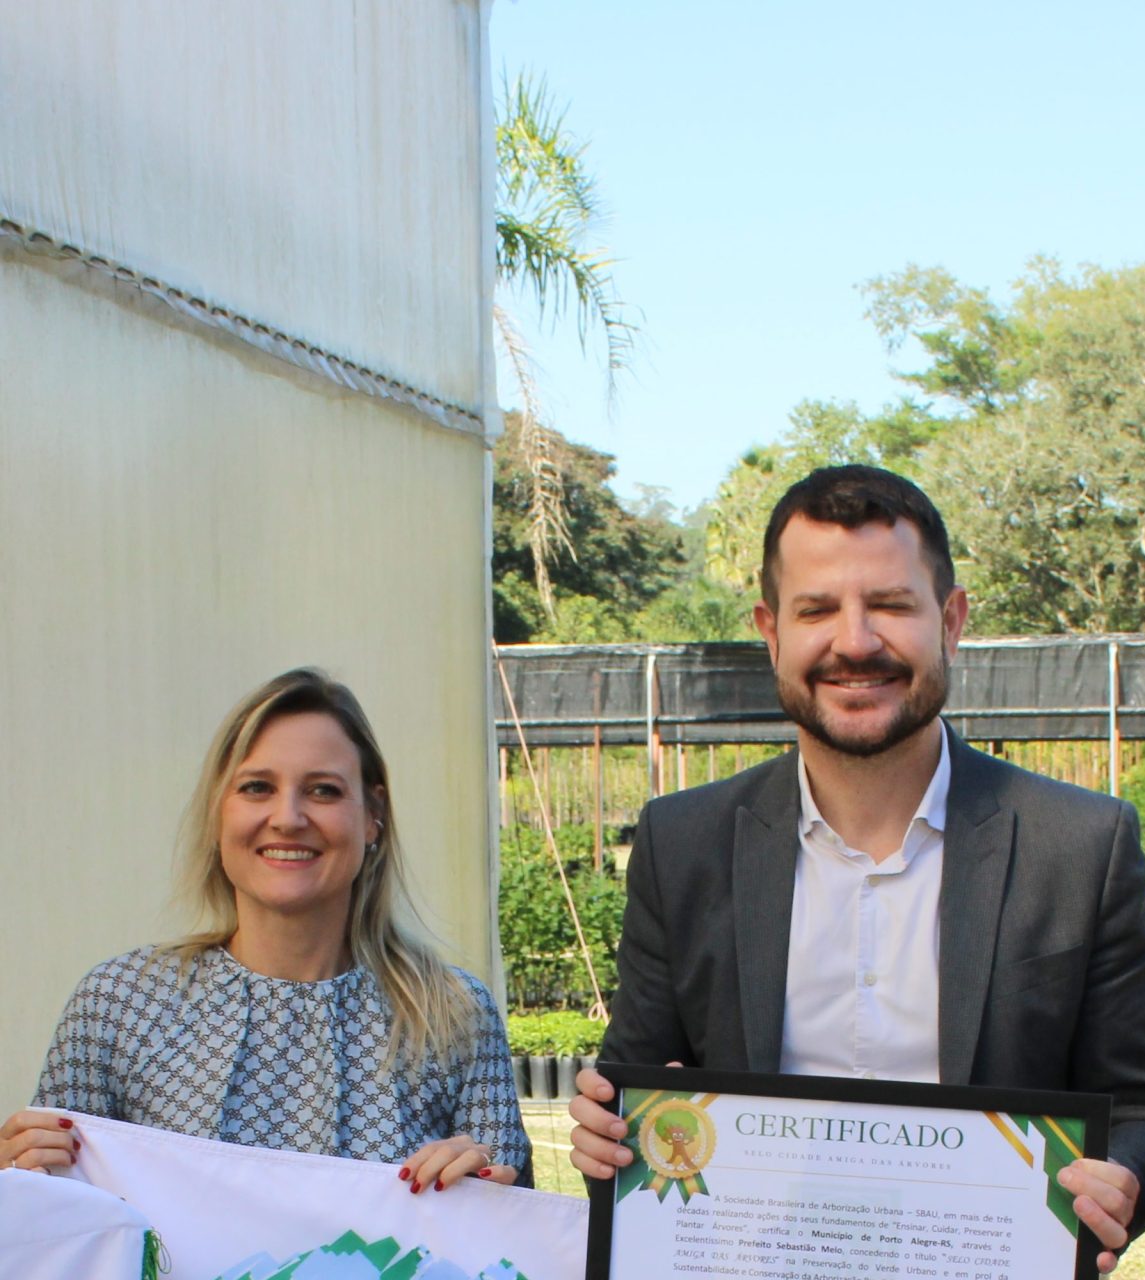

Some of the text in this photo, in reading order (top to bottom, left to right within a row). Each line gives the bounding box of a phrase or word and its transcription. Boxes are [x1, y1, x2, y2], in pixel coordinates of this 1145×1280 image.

[735, 1112, 964, 1150] CERTIFICADO
[676, 1206, 710, 1217] décadas
[712, 1209, 754, 1220] realizando
[757, 1212, 780, 1223] ações
[783, 1213, 798, 1223] dos
[800, 1216, 819, 1224] seus
[821, 1217, 876, 1229] fundamentos
[878, 1220, 889, 1229] de
[931, 1224, 961, 1236] Cuidar,
[964, 1226, 1003, 1238] Preservar
[714, 1195, 721, 1203] A
[724, 1195, 765, 1207] Sociedade
[768, 1198, 805, 1209] Brasileira
[808, 1201, 819, 1210] de
[822, 1202, 871, 1214] Arborização
[874, 1206, 904, 1216] Urbana
[916, 1209, 941, 1220] SBAU,
[943, 1212, 957, 1220] em
[960, 1213, 980, 1222] mais
[982, 1214, 993, 1223] de
[676, 1219, 704, 1230] Plantar
[757, 1226, 790, 1237] certifica
[811, 1230, 853, 1241] Município
[861, 1233, 872, 1242] de
[879, 1235, 903, 1245] Porto
[911, 1237, 954, 1249] Alegre-RS,
[1000, 1243, 1012, 1252] do
[738, 1238, 772, 1249] Prefeito
[776, 1242, 816, 1252] Sebastião
[850, 1248, 900, 1260] concedendo
[673, 1262, 739, 1276] Sustentabilidade
[741, 1268, 747, 1276] e
[748, 1267, 799, 1280] Conservação
[801, 1272, 812, 1280] da
[786, 1257, 796, 1266] na
[802, 1258, 852, 1271] Preservação
[858, 1262, 869, 1271] do
[875, 1264, 900, 1273] Verde
[906, 1266, 937, 1276] Urbano
[955, 1271, 969, 1279] em
